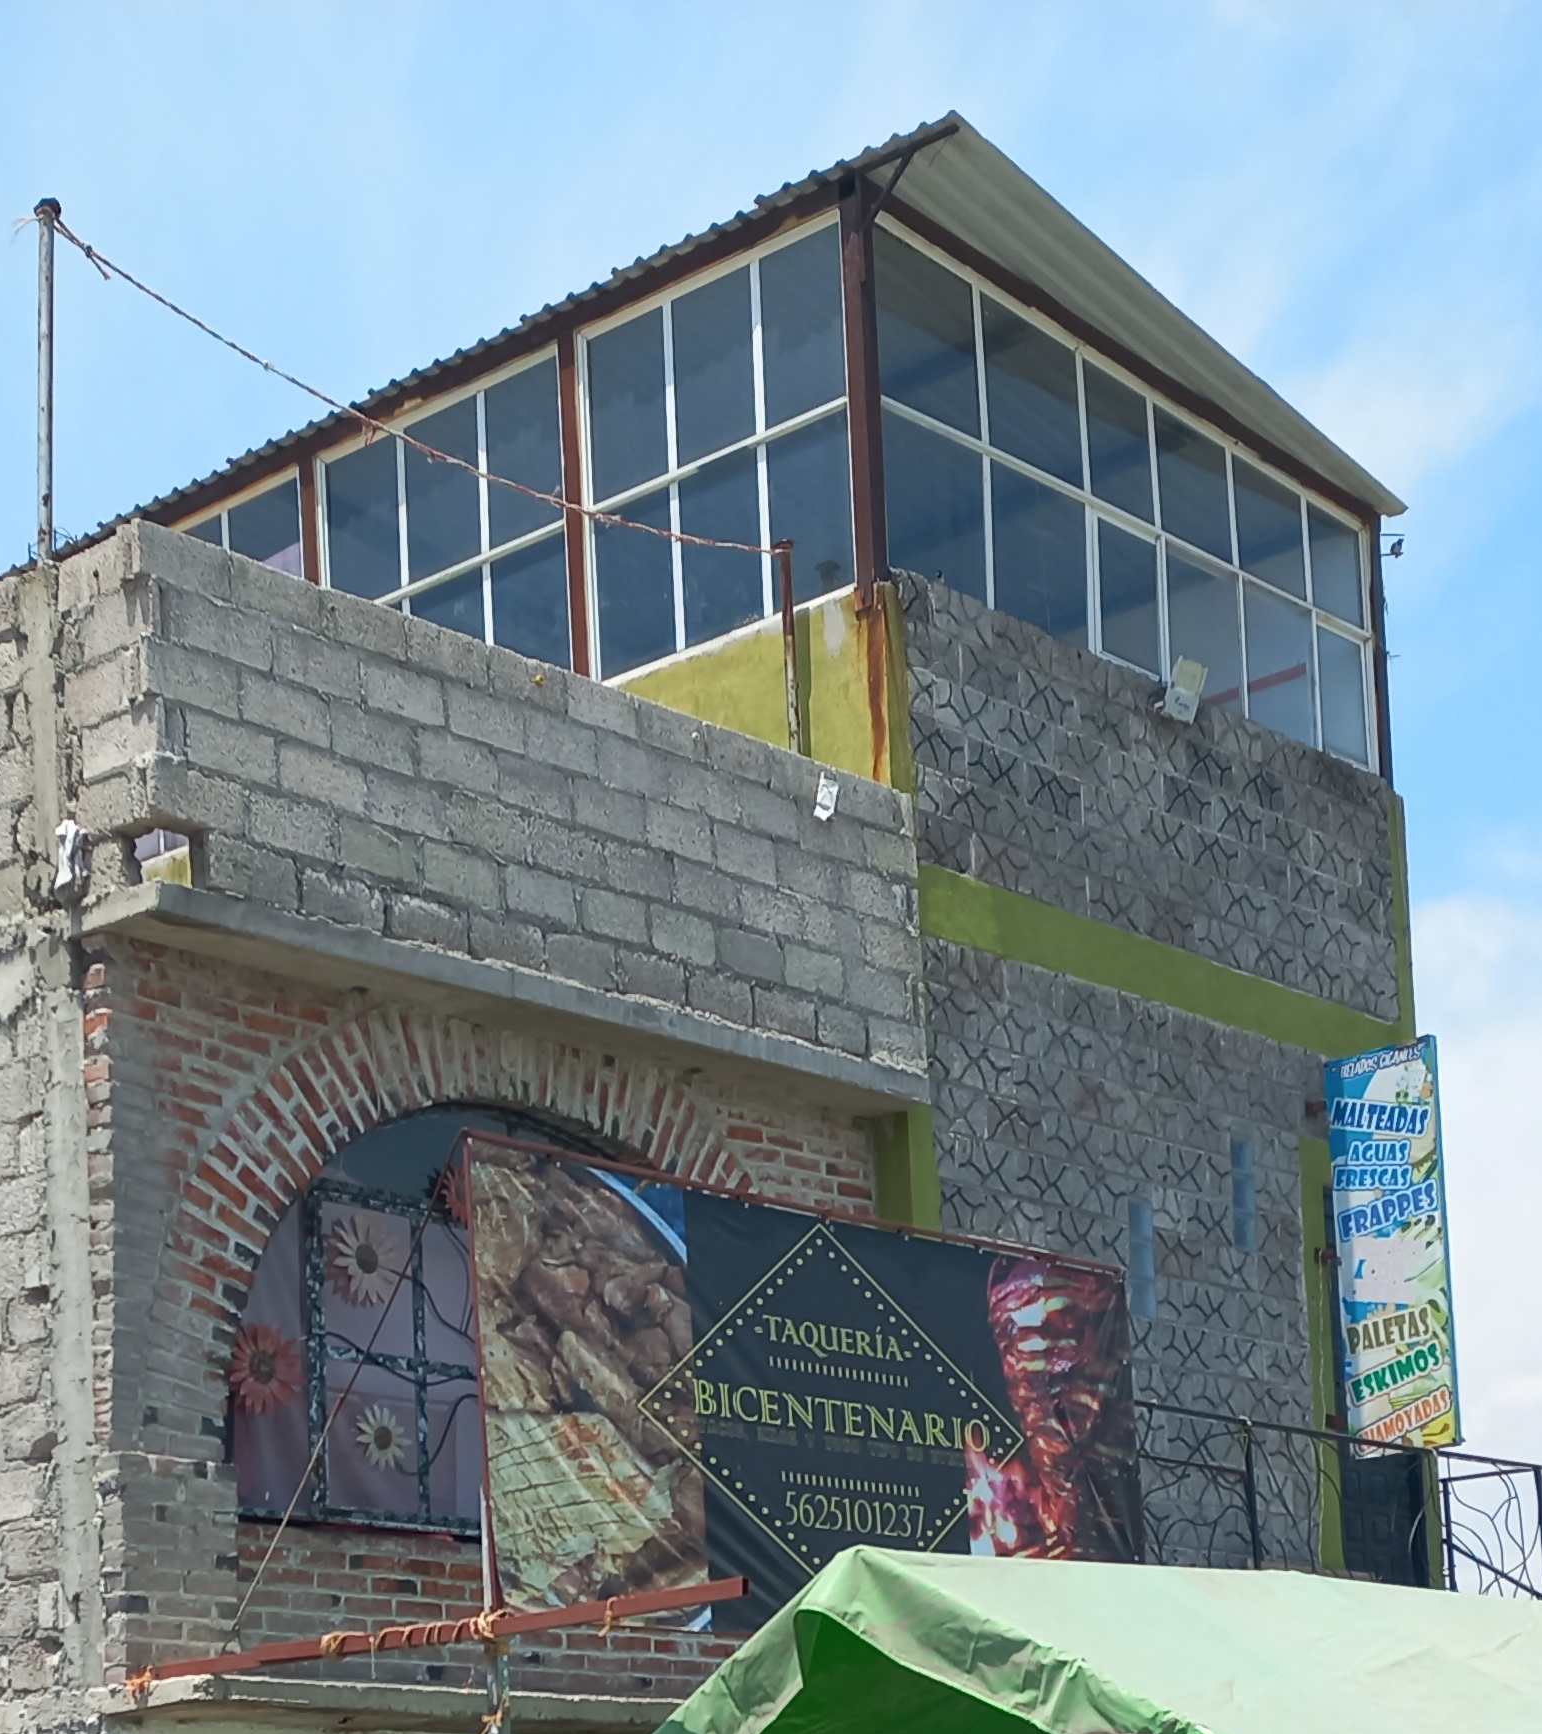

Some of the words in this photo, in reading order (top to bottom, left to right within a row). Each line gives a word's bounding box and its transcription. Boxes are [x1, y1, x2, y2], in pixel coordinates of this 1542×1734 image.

[1332, 1100, 1429, 1135] MALTEADAS
[1349, 1141, 1409, 1162] AGUAS
[1335, 1167, 1410, 1187] FRESCAS
[1340, 1182, 1436, 1241] FRAPPES
[762, 1314, 904, 1361] TAQUERÍA
[1346, 1306, 1430, 1355] PALETAS
[1351, 1342, 1440, 1404] ESKIMOS
[692, 1378, 991, 1453] BICENTENARIO
[785, 1491, 924, 1538] 5625101237
